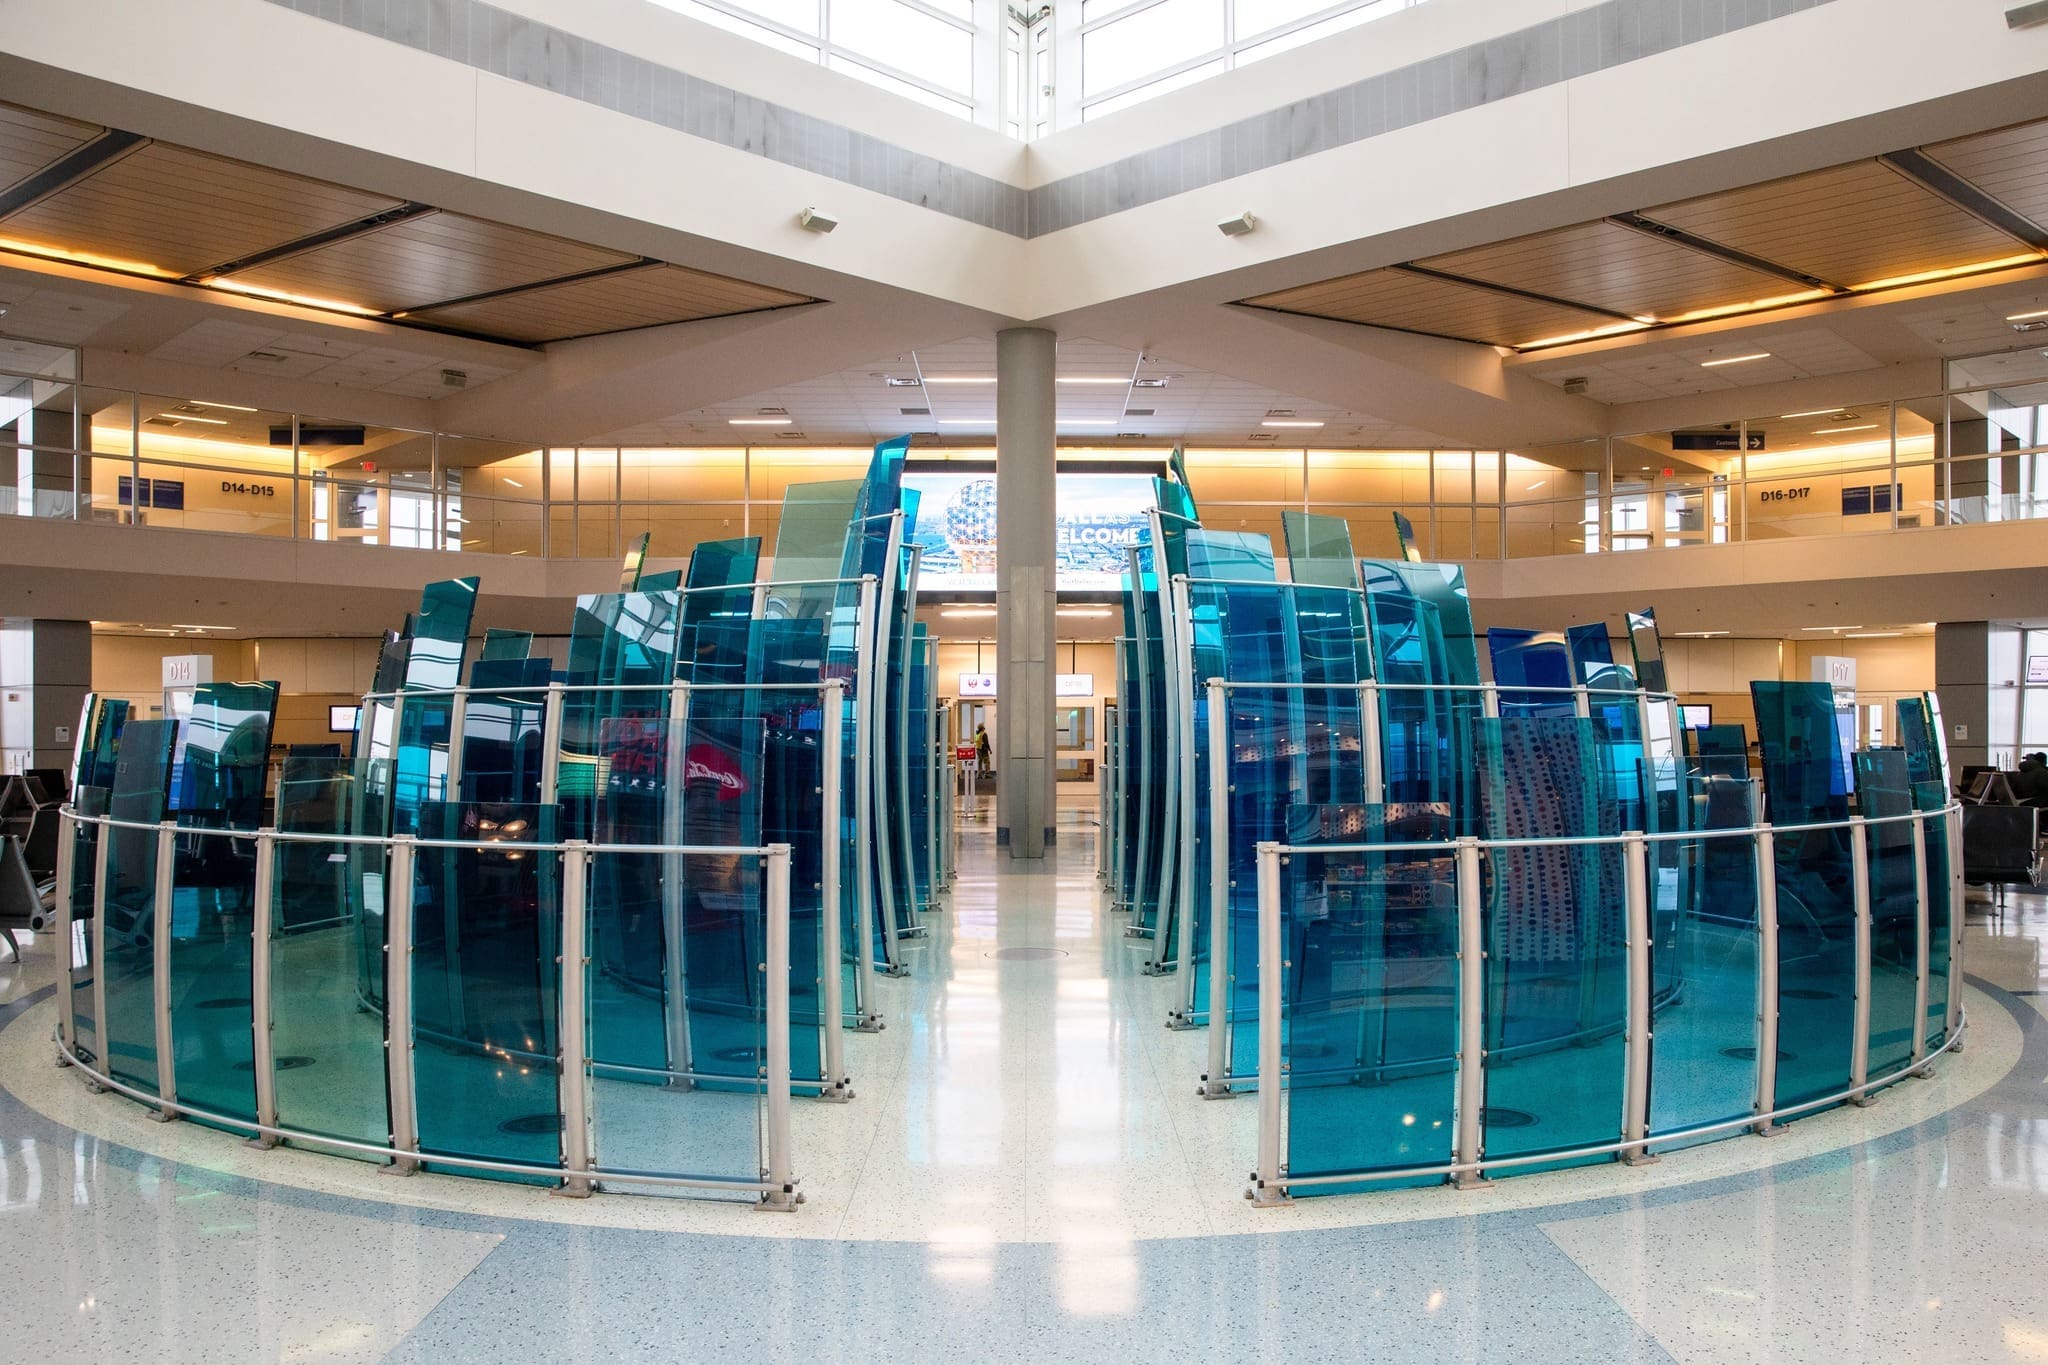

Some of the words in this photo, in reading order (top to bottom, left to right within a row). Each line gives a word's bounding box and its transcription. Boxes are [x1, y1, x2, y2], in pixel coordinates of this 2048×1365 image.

[222, 481, 274, 496] D14-D15
[1761, 487, 1810, 501] D16-D17
[1056, 527, 1138, 544] ELCOME
[169, 661, 190, 681] D14
[1832, 663, 1849, 681] D17
